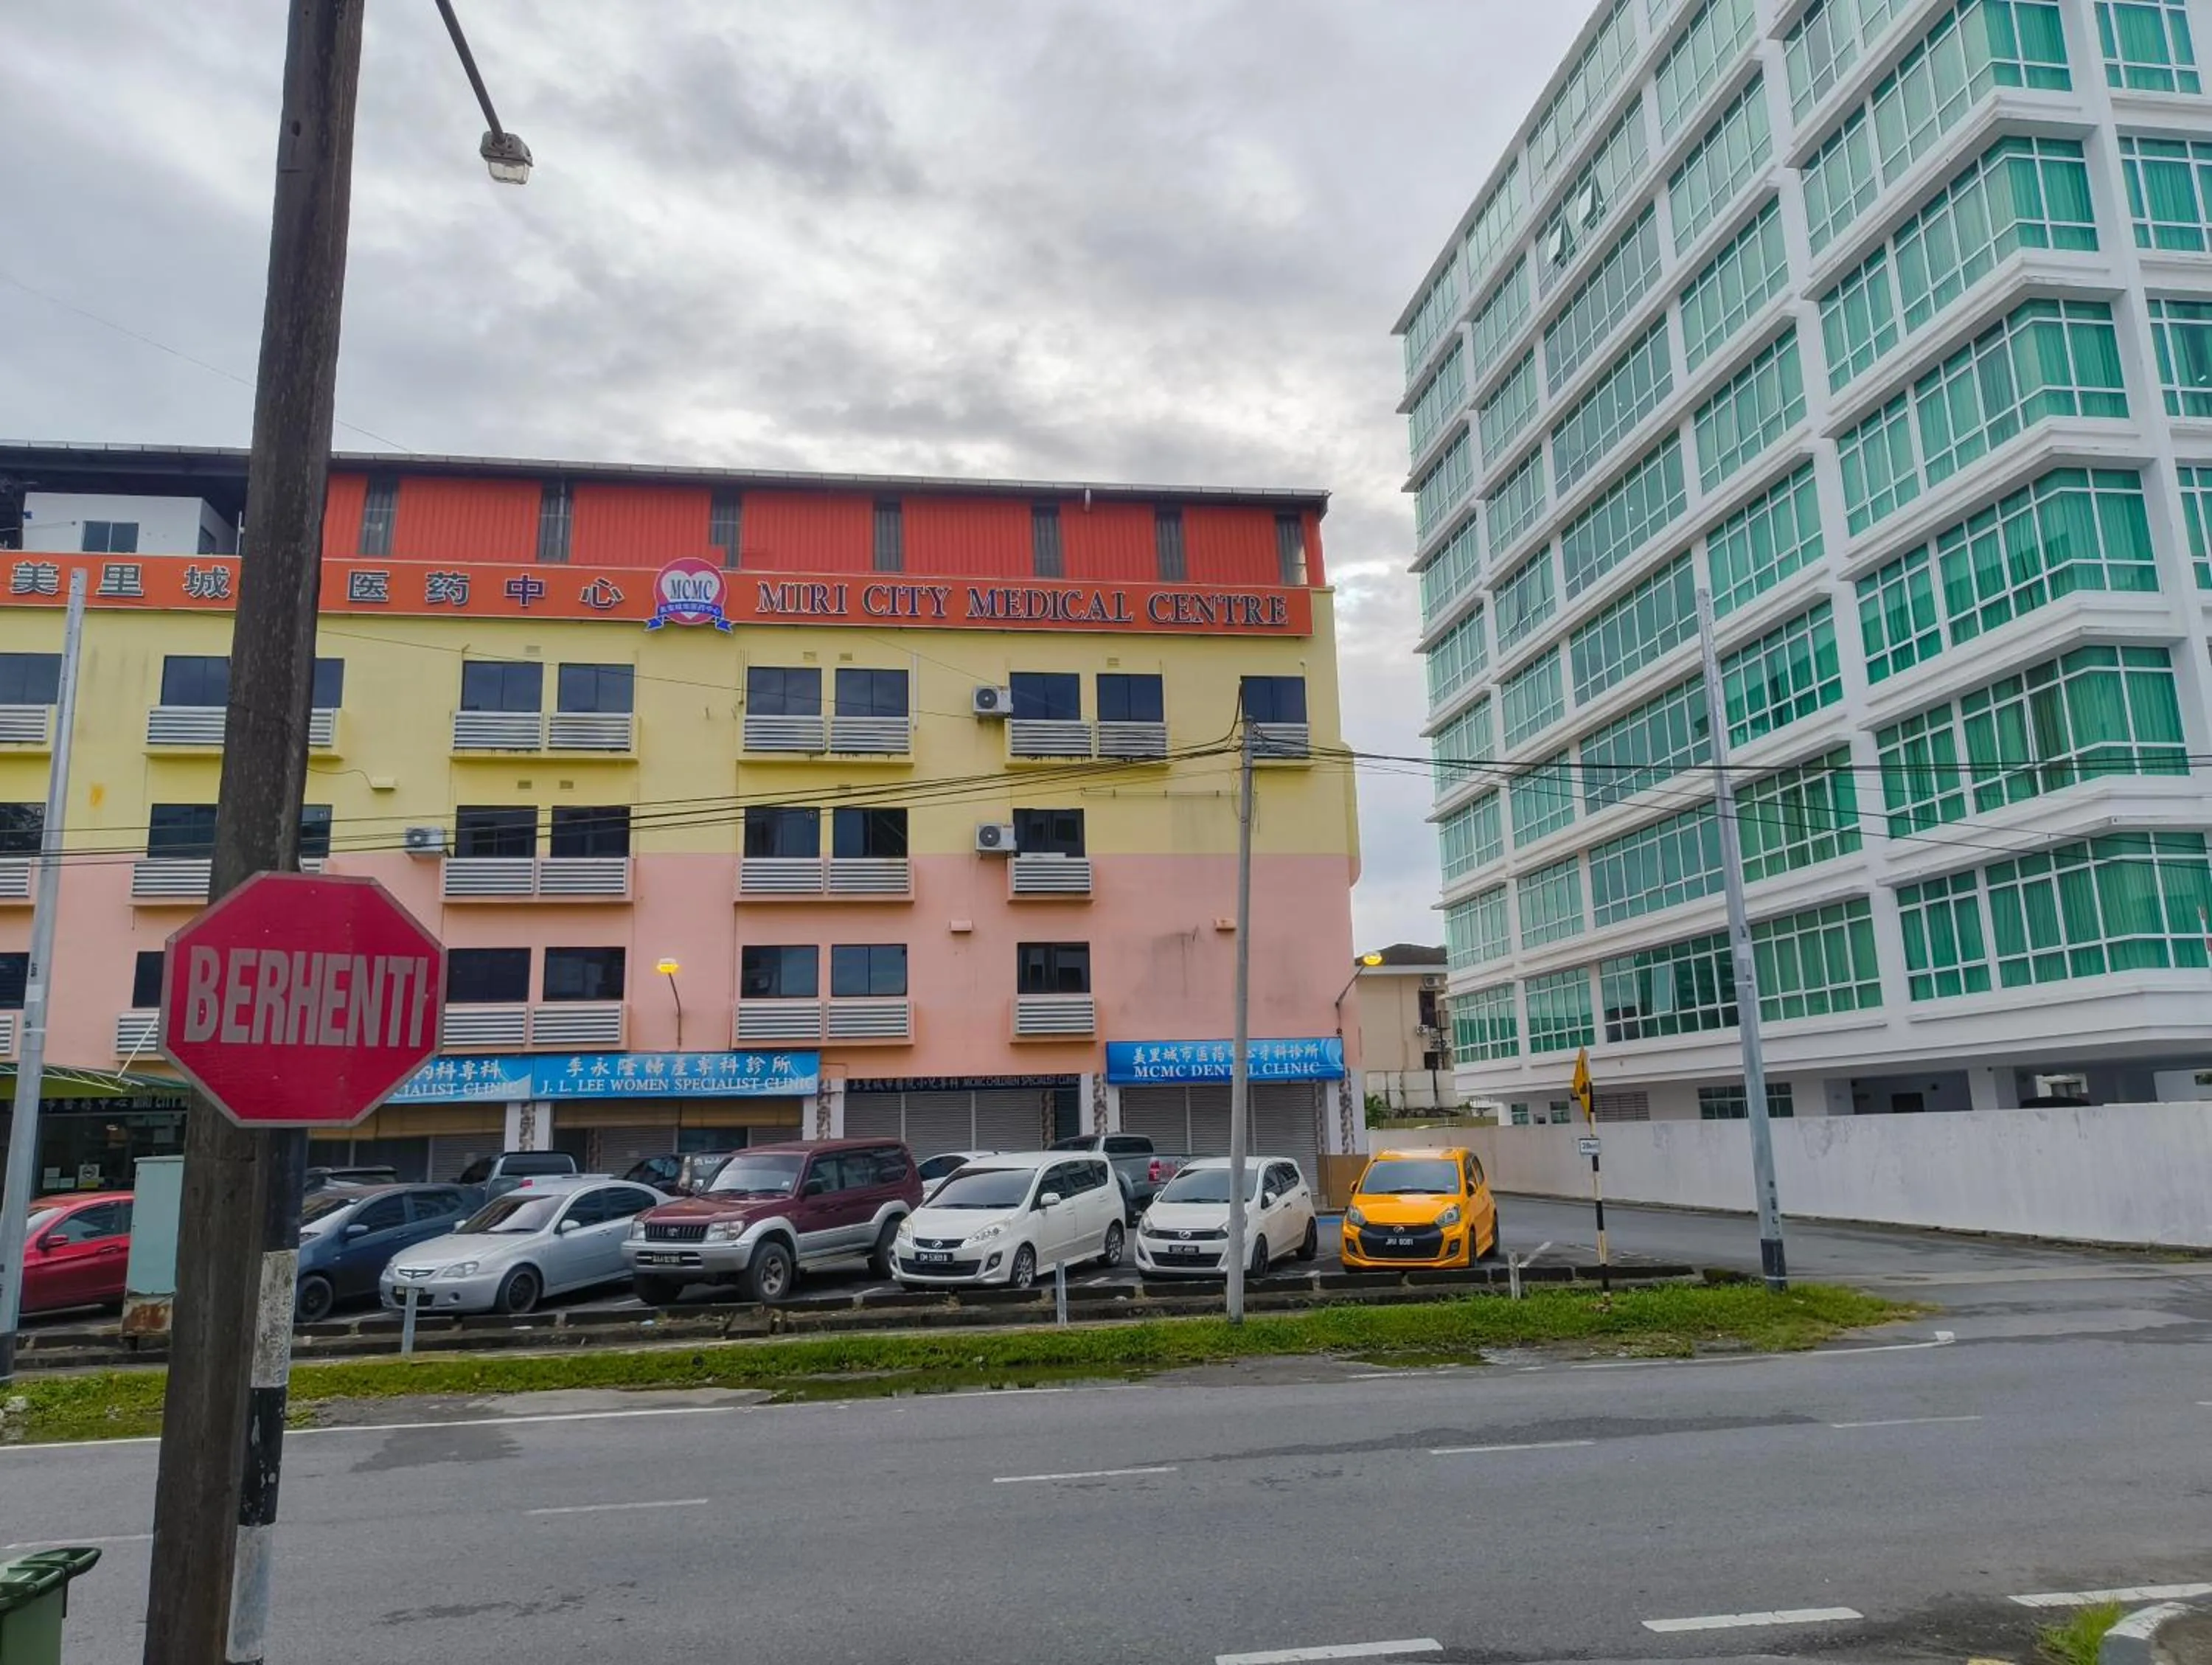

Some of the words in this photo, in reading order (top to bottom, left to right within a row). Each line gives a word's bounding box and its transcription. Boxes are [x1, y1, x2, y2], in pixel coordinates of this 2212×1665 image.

[670, 579, 713, 601] MCMC
[755, 580, 849, 615] MIRI
[862, 583, 952, 618] CITY
[966, 587, 1133, 624] MEDICAL
[1146, 592, 1288, 626] CENTRE
[184, 945, 429, 1049] BERHENTI
[1133, 1064, 1187, 1077] MCMC
[1191, 1063, 1259, 1077] DENTL
[1262, 1062, 1320, 1074] CLINIC
[394, 1082, 457, 1097] IALIST
[559, 1080, 571, 1092] L.
[577, 1079, 605, 1092] LEE
[611, 1078, 669, 1092] WOMEN
[675, 1077, 759, 1091] SPECIALIST
[764, 1077, 815, 1090] CLINIC
